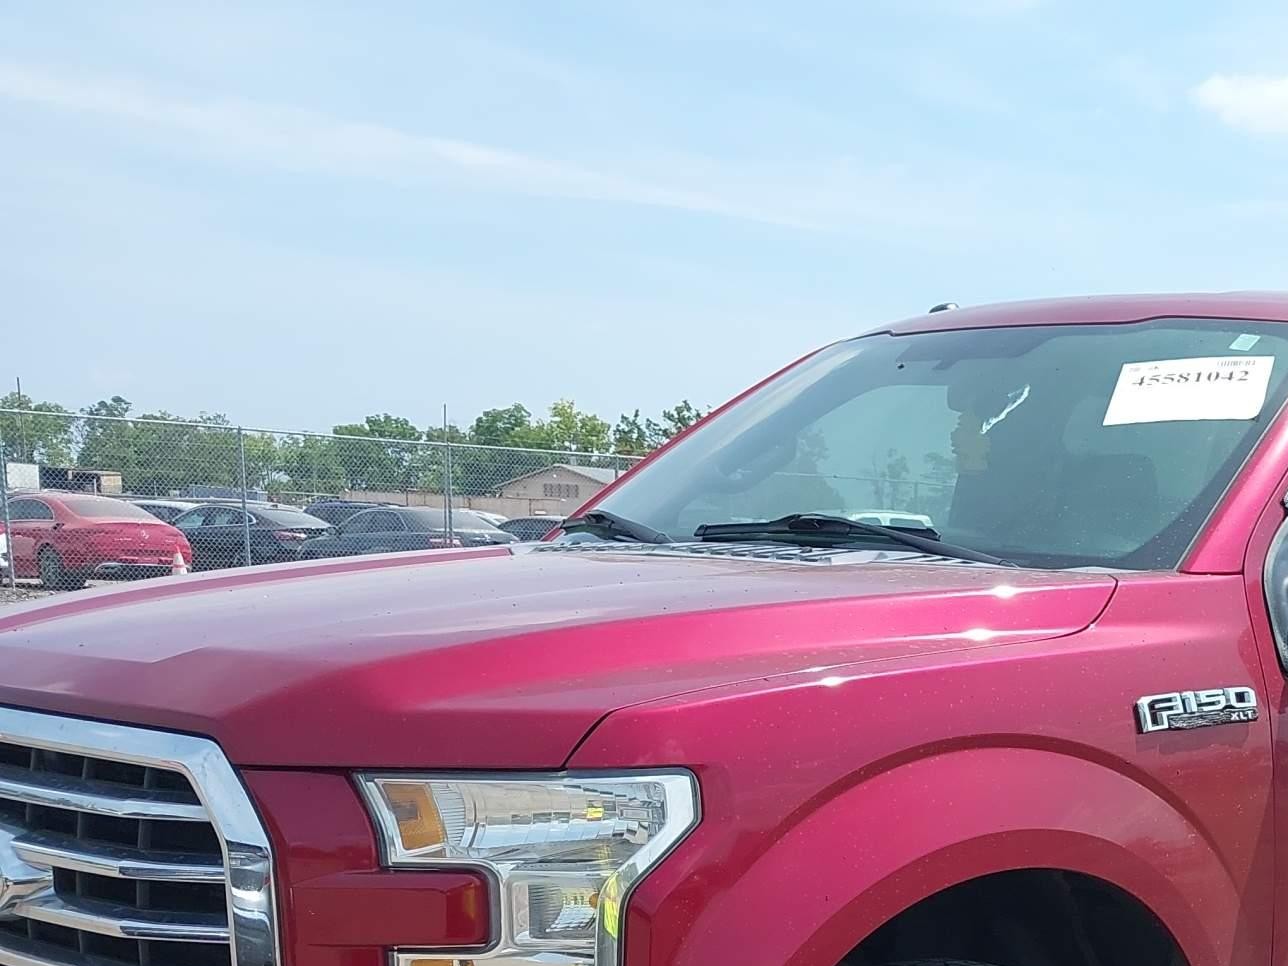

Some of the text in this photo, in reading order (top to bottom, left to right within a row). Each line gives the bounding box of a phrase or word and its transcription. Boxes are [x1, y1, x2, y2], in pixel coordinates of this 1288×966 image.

[1132, 370, 1249, 386] 45581042
[1136, 686, 1257, 733] F150
[1230, 710, 1254, 721] XLT
